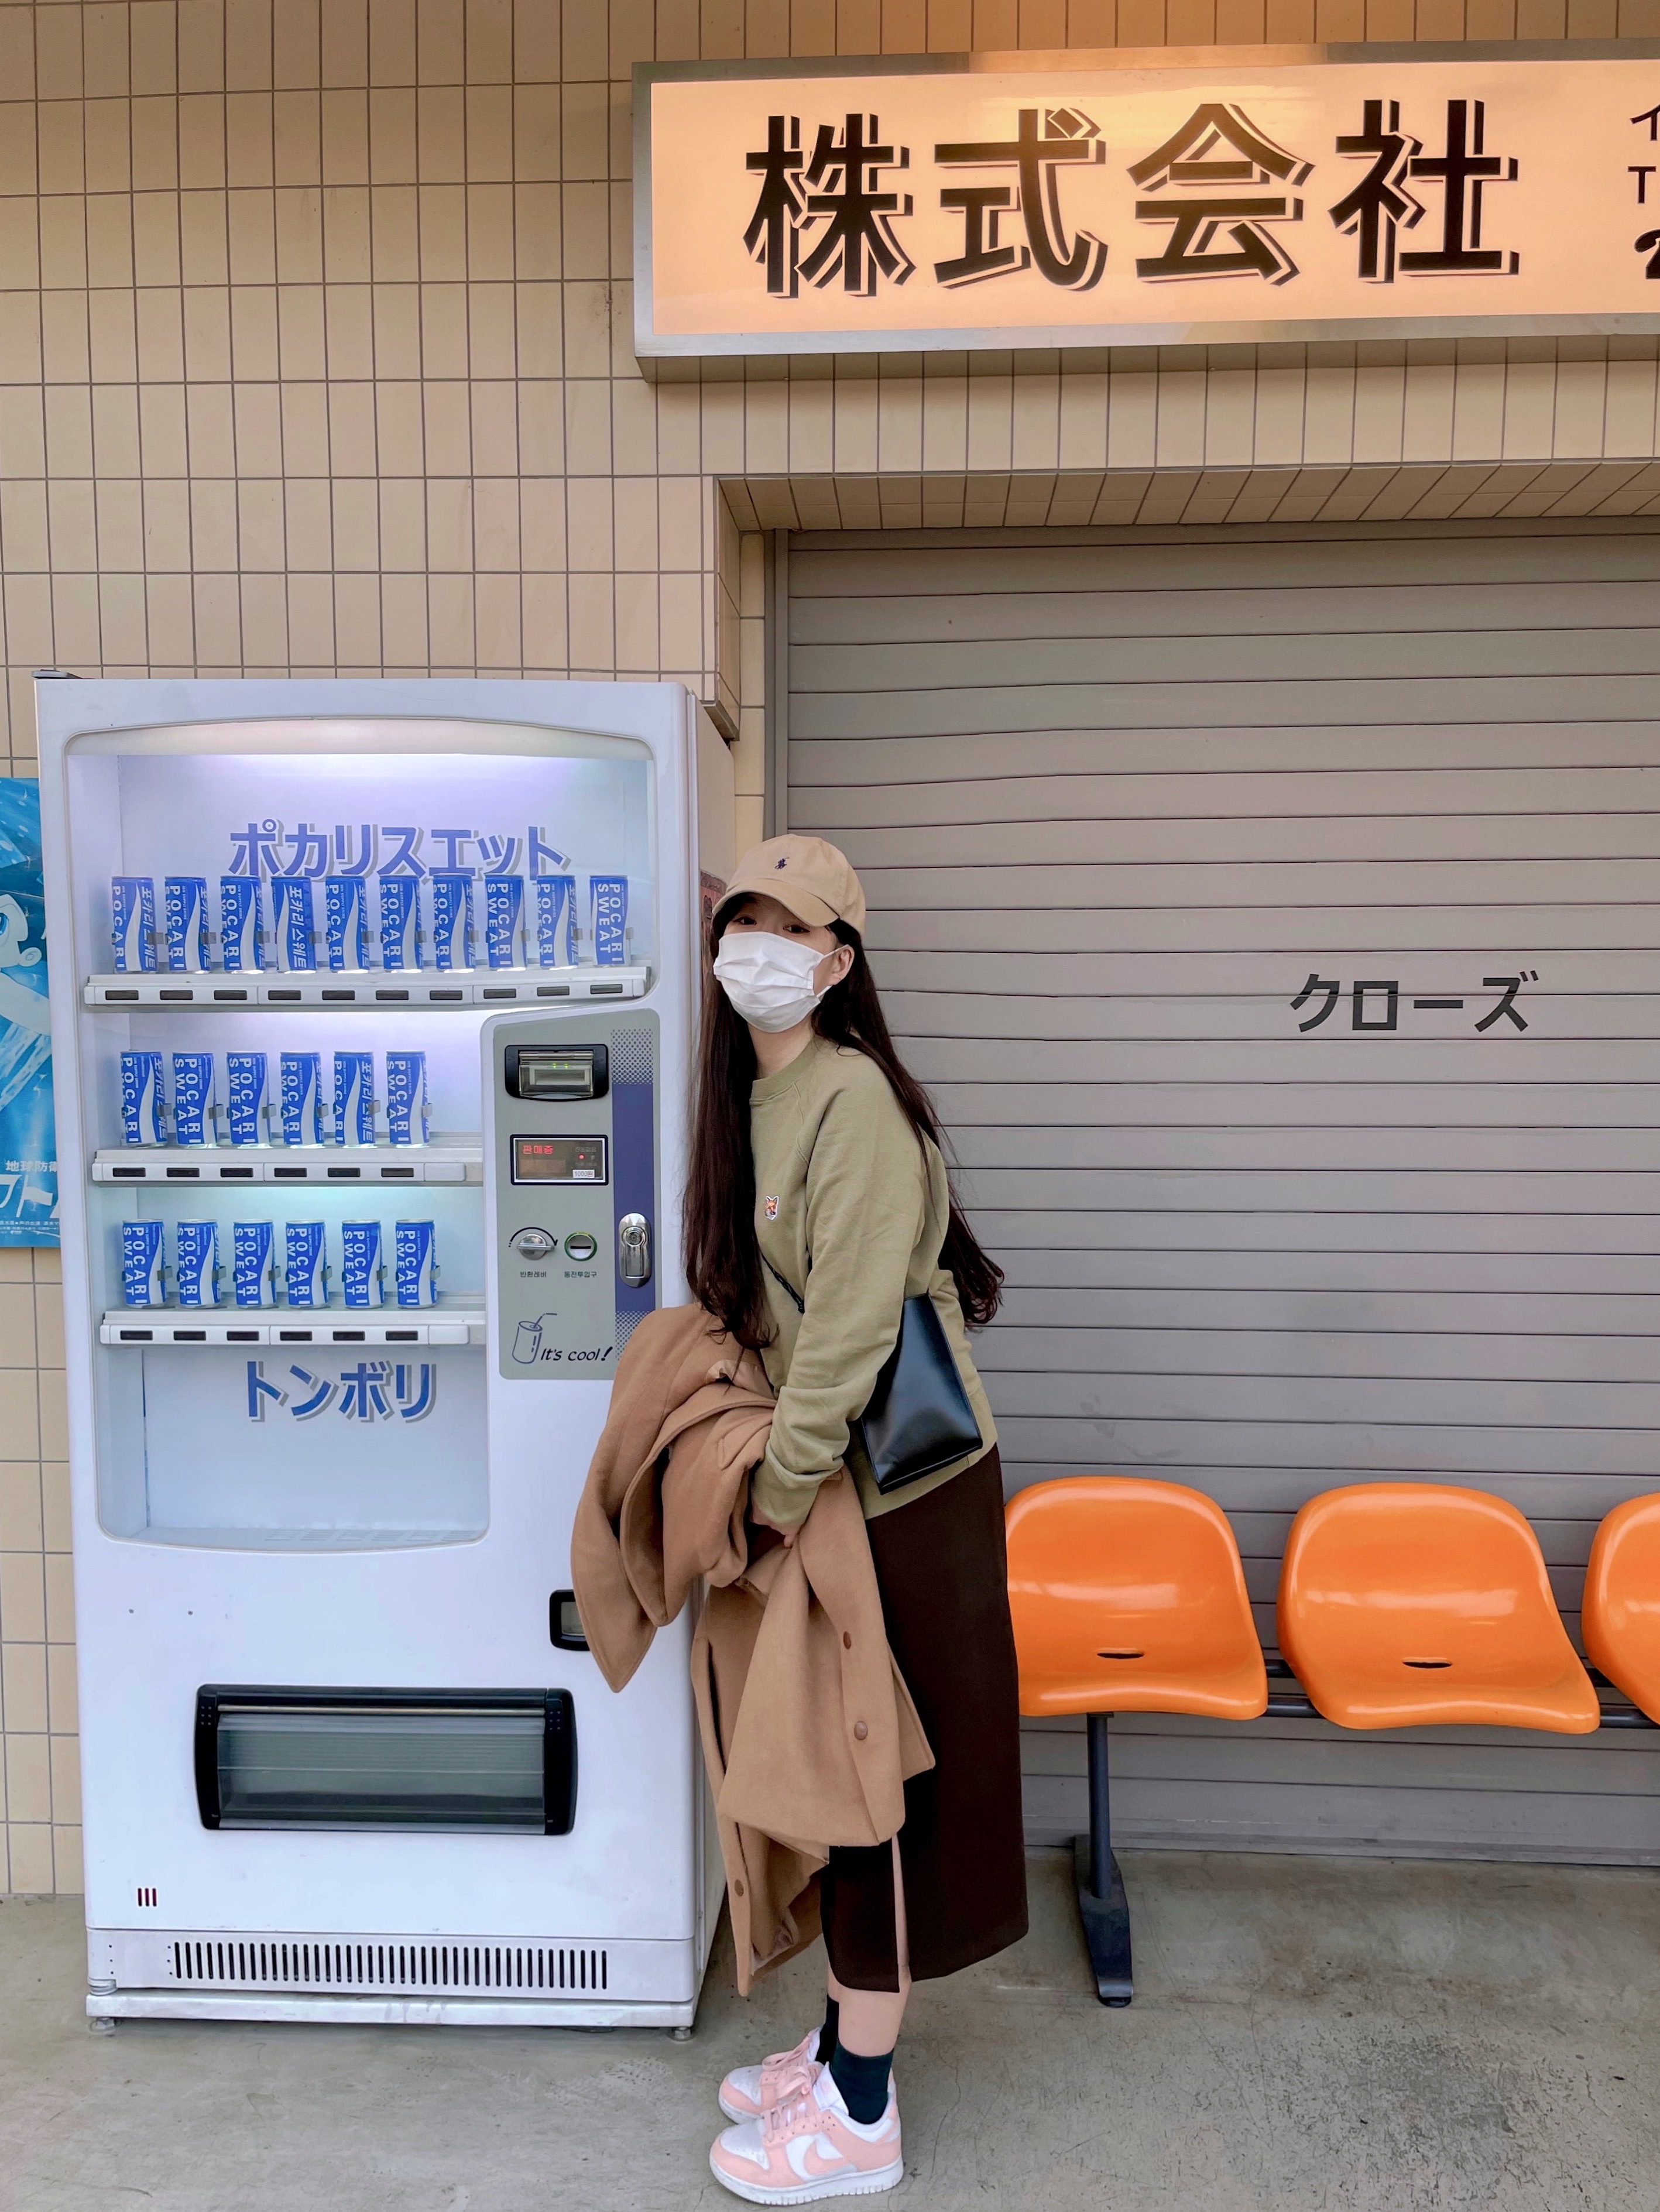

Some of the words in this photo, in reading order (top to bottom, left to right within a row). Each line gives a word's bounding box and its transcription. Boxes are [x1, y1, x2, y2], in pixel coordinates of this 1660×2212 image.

[745, 98, 1519, 299] 株式会社
[228, 819, 571, 882] ポカリスエット
[112, 886, 125, 968] POCARI
[170, 885, 184, 968] POCARI
[225, 884, 239, 968] POCARI
[329, 884, 343, 967] POCARI
[380, 884, 390, 958] SWEAT
[387, 883, 402, 966] POCARI
[437, 883, 450, 966] POCARI
[487, 883, 499, 956] SWEAT
[496, 883, 512, 965] POCARI
[541, 883, 554, 964] POCARI
[597, 883, 611, 954] SWEAT
[609, 883, 623, 962] POCARI
[1289, 969, 1539, 1033] クローズ
[123, 1057, 139, 1142] POCARI
[176, 1058, 188, 1135] SWEAT
[184, 1058, 202, 1143] POCARI
[229, 1058, 242, 1135] SWEAT
[239, 1058, 256, 1143] POCARI
[286, 1061, 301, 1142] POCARI
[335, 1061, 344, 1141] POCARI
[387, 1061, 397, 1133] SWEAT
[395, 1061, 410, 1141] POCARI
[124, 1227, 135, 1296] SWEAT
[132, 1227, 148, 1304] POCARI
[184, 1227, 199, 1304] POCARI
[235, 1227, 246, 1297] SWEAT
[243, 1227, 259, 1304] POCARI
[287, 1227, 297, 1297] SWEAT
[295, 1228, 311, 1305] POCARI
[344, 1230, 355, 1296] SWEAT
[354, 1230, 368, 1304] POCARI
[396, 1230, 406, 1295] SWEAT
[404, 1230, 418, 1303] POCARI
[246, 1360, 437, 1423] トンボリ
[540, 1348, 563, 1361] It's
